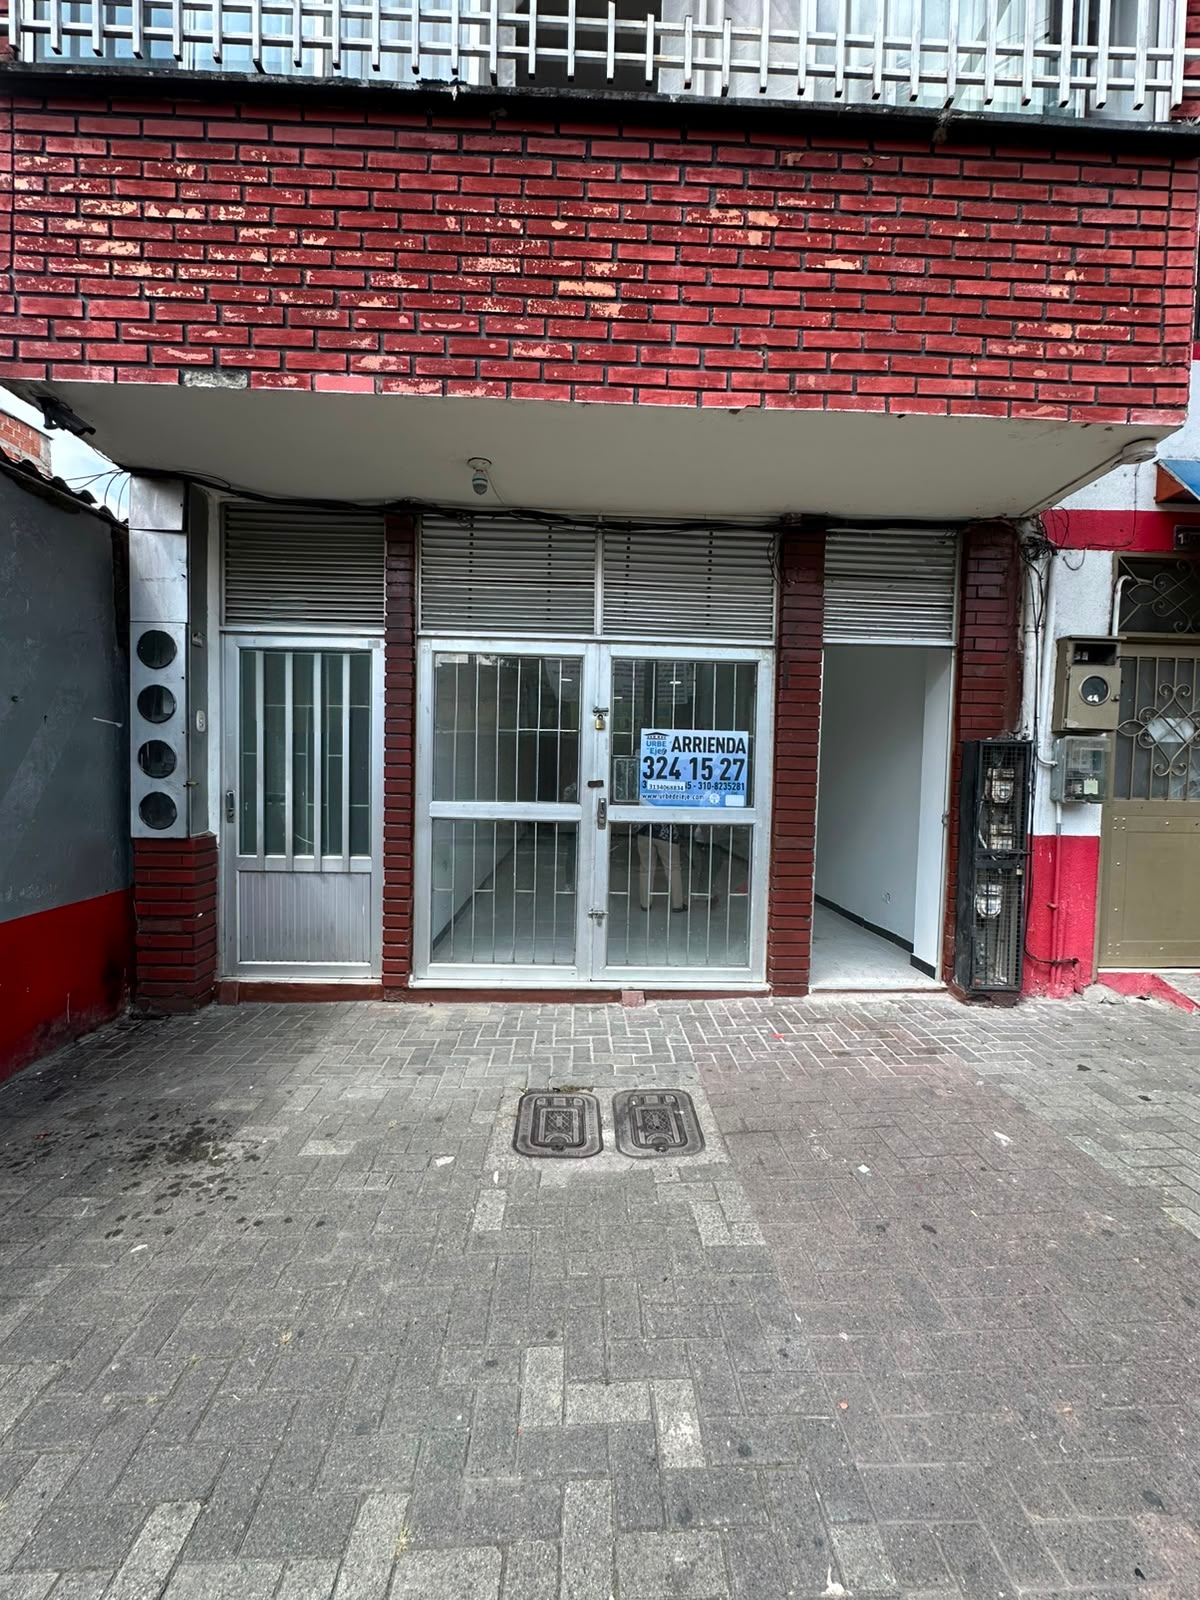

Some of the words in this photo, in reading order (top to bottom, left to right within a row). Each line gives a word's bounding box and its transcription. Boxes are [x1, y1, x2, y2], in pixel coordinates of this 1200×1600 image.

[646, 740, 667, 748] URBE
[671, 736, 746, 754] ARRIENDA
[642, 755, 682, 780] 324
[689, 757, 713, 781] 15
[720, 758, 746, 782] 27
